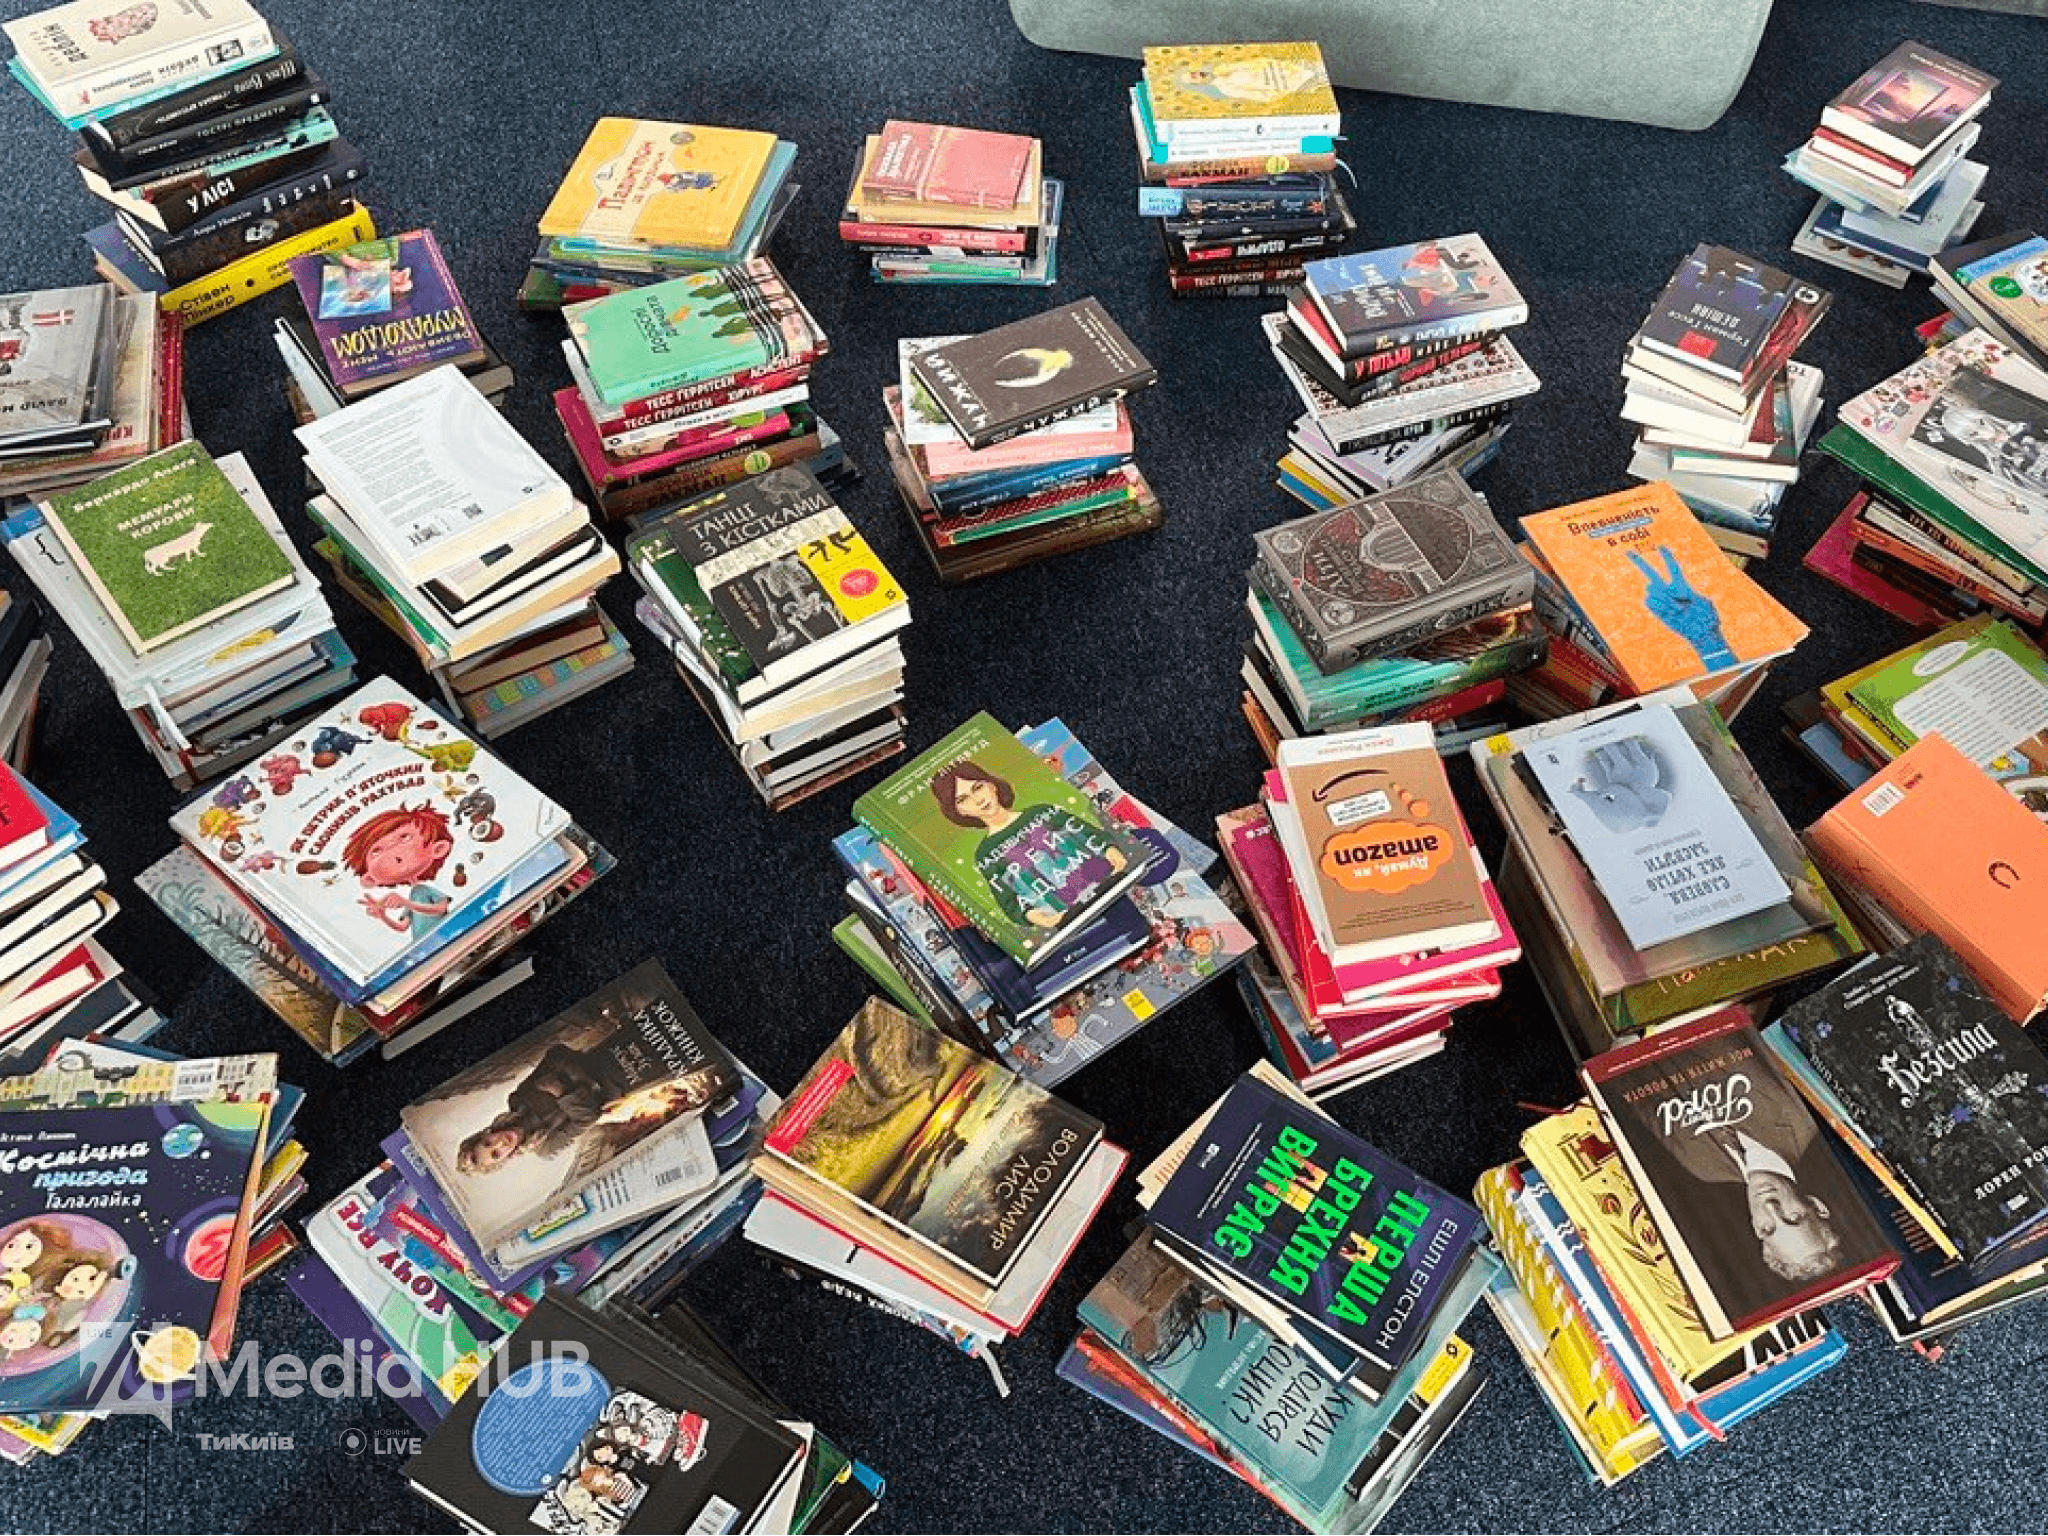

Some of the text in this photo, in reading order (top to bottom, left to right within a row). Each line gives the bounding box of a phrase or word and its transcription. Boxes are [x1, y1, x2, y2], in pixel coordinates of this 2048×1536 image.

[187, 196, 199, 212] У
[623, 413, 651, 429] ТЕСС
[646, 393, 675, 410] ТЕСС
[687, 498, 758, 545] ТАНЦІ
[698, 488, 829, 559] З КІСТКАМИ
[302, 794, 346, 835] ПЕТРИК
[362, 777, 425, 808] РАХУВАВ
[1010, 830, 1110, 913] АДАМС
[1332, 834, 1439, 867] amazon
[652, 1000, 703, 1066] КНИЖОК
[1657, 1073, 1753, 1136] Ford
[0, 1140, 149, 1174] Космічна
[32, 1169, 148, 1193] пригода
[995, 1152, 1030, 1198] ЛИС
[991, 1128, 1077, 1251] ВОЛОДИМИР
[1214, 1125, 1318, 1259] ВИГРАЄ
[1269, 1157, 1374, 1296] БРЕХНЯ
[1327, 1190, 1430, 1325] ПЕРША
[379, 1251, 451, 1316] ХОЧУ
[1377, 1218, 1458, 1349] ЕШЛІ ЕЛСТОН
[1300, 1393, 1354, 1456] КУДИ
